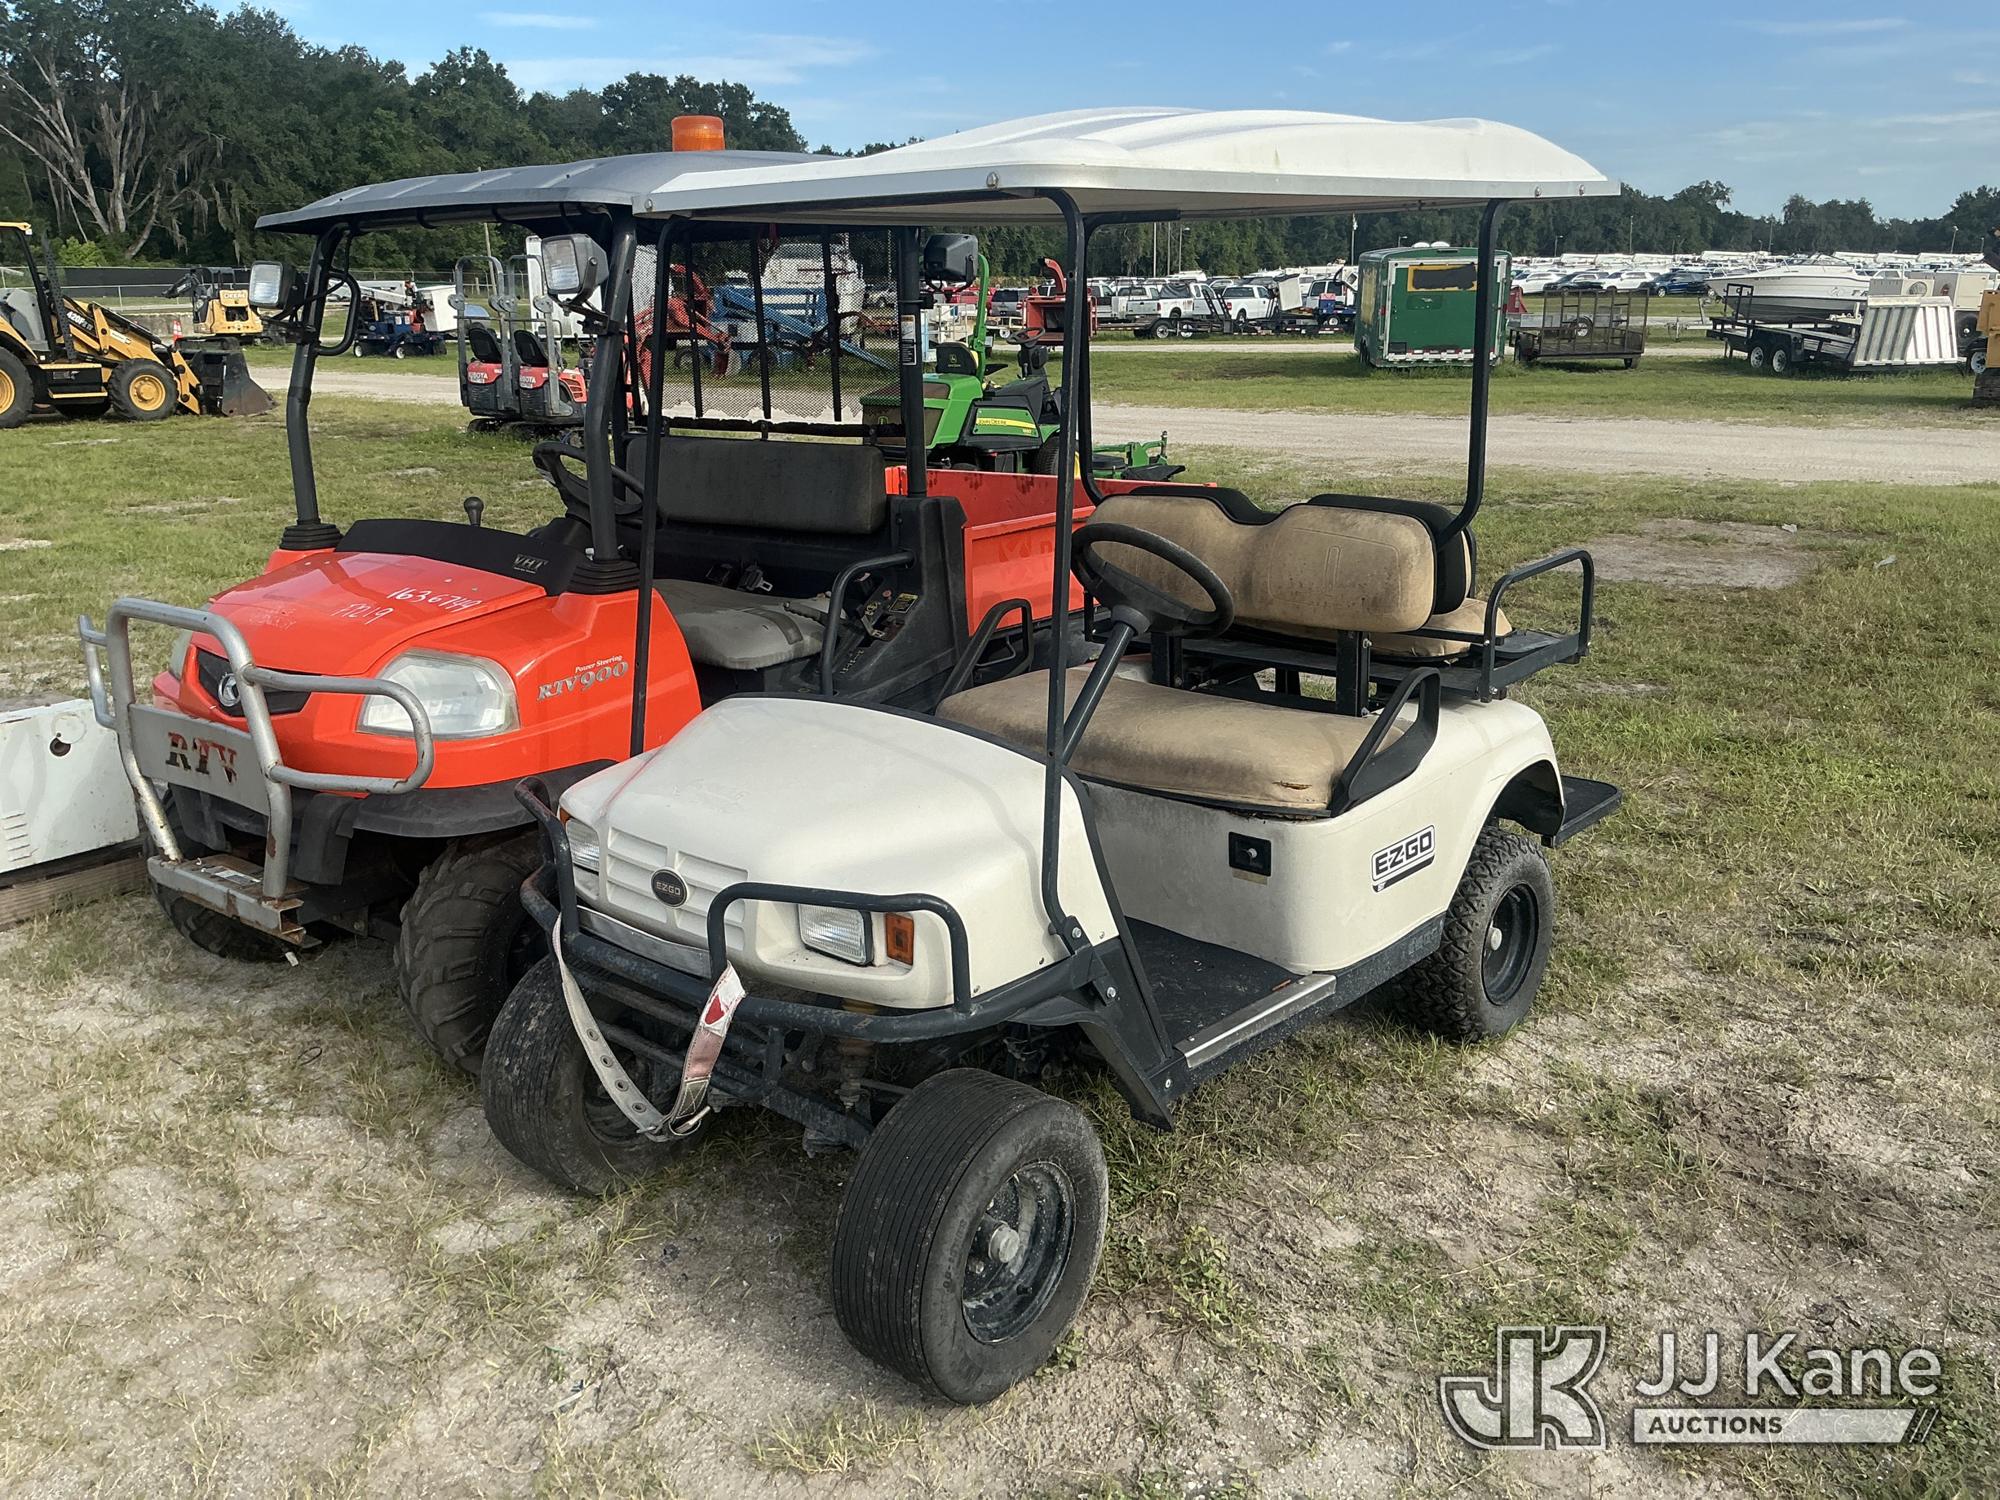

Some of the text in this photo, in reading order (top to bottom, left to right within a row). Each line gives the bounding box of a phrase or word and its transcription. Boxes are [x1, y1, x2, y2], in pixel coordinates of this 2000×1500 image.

[575, 655, 622, 673] Power Steering
[165, 731, 238, 784] RTV
